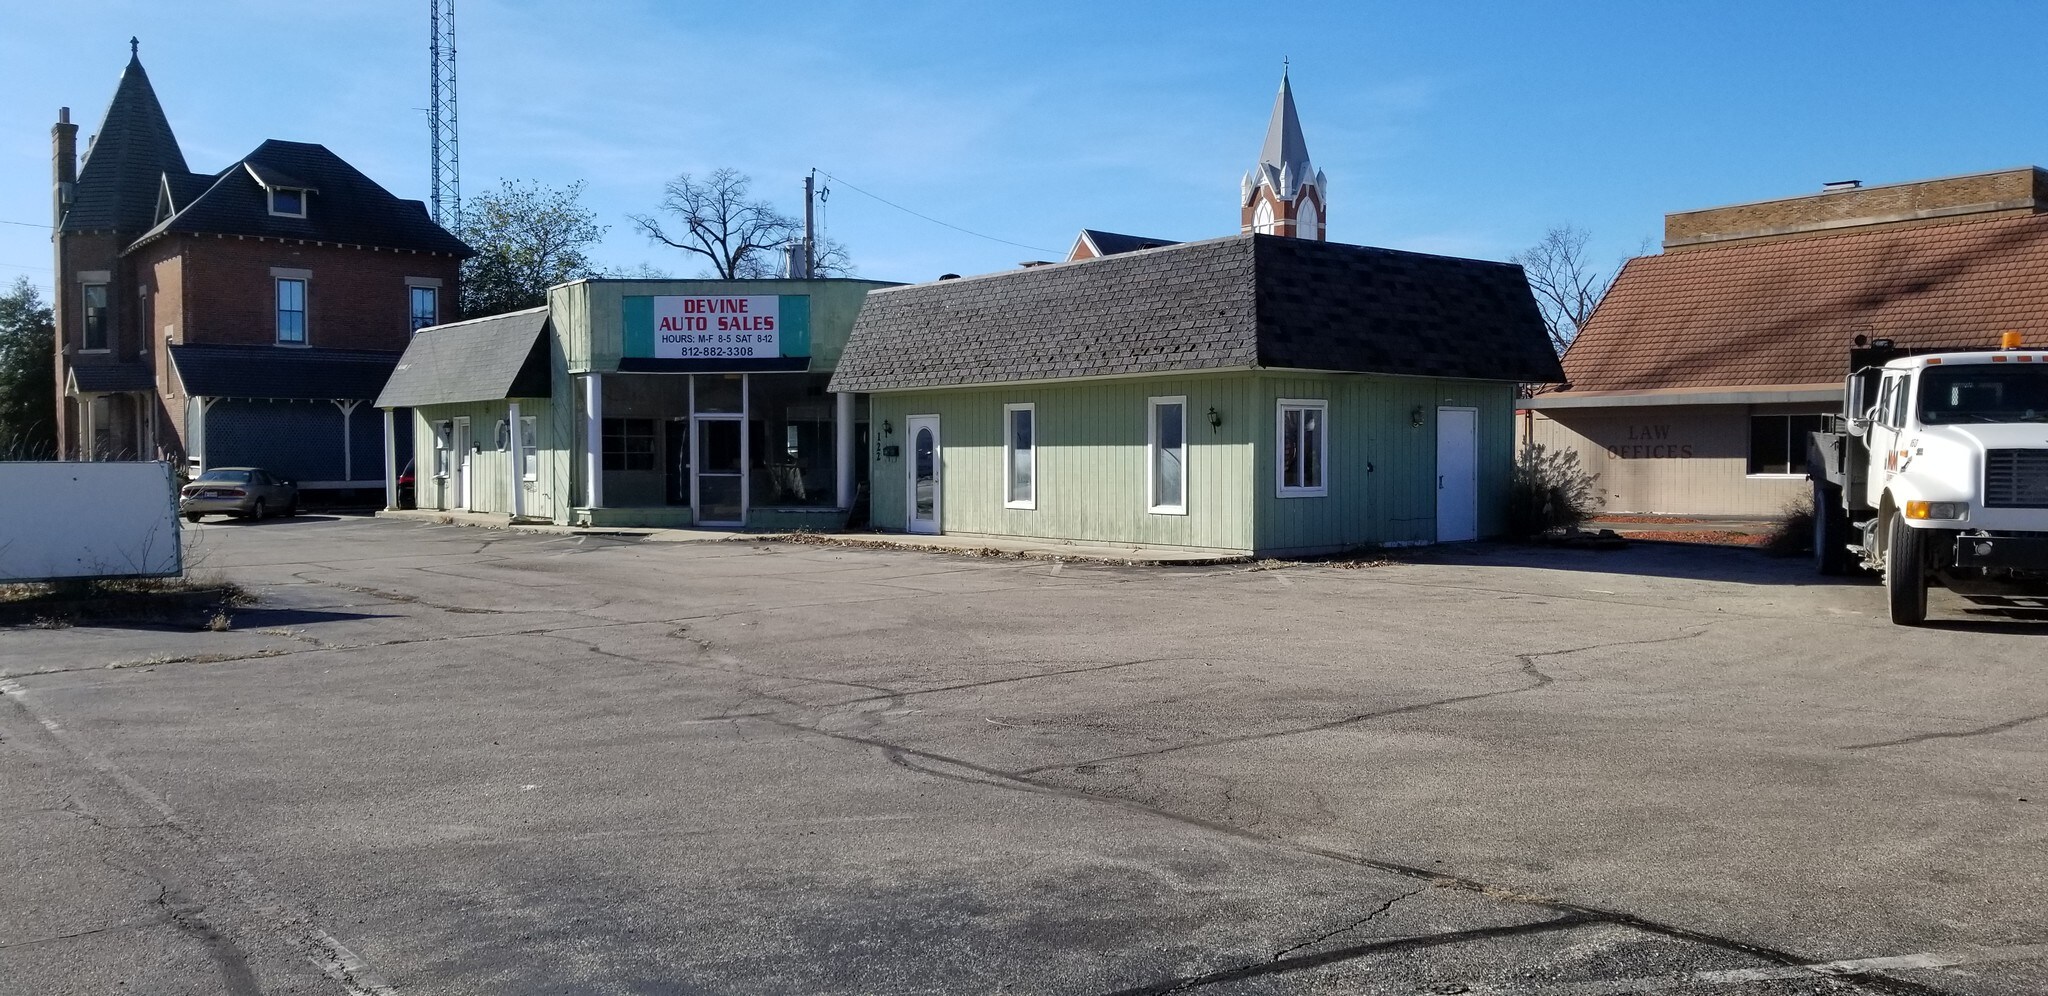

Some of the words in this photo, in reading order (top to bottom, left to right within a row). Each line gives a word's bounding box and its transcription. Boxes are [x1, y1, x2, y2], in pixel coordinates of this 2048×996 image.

[684, 299, 748, 313] DEVINE
[659, 316, 708, 331] AUTO
[718, 316, 774, 331] SALES
[661, 334, 695, 343] HOURS:
[698, 334, 713, 343] M-F
[717, 334, 732, 343] 8-5
[735, 334, 752, 343] SAT
[757, 334, 773, 343] 8-12
[681, 347, 754, 357] 812-882-3308
[1628, 424, 1672, 440] LAW
[1607, 444, 1693, 460] OFFICES
